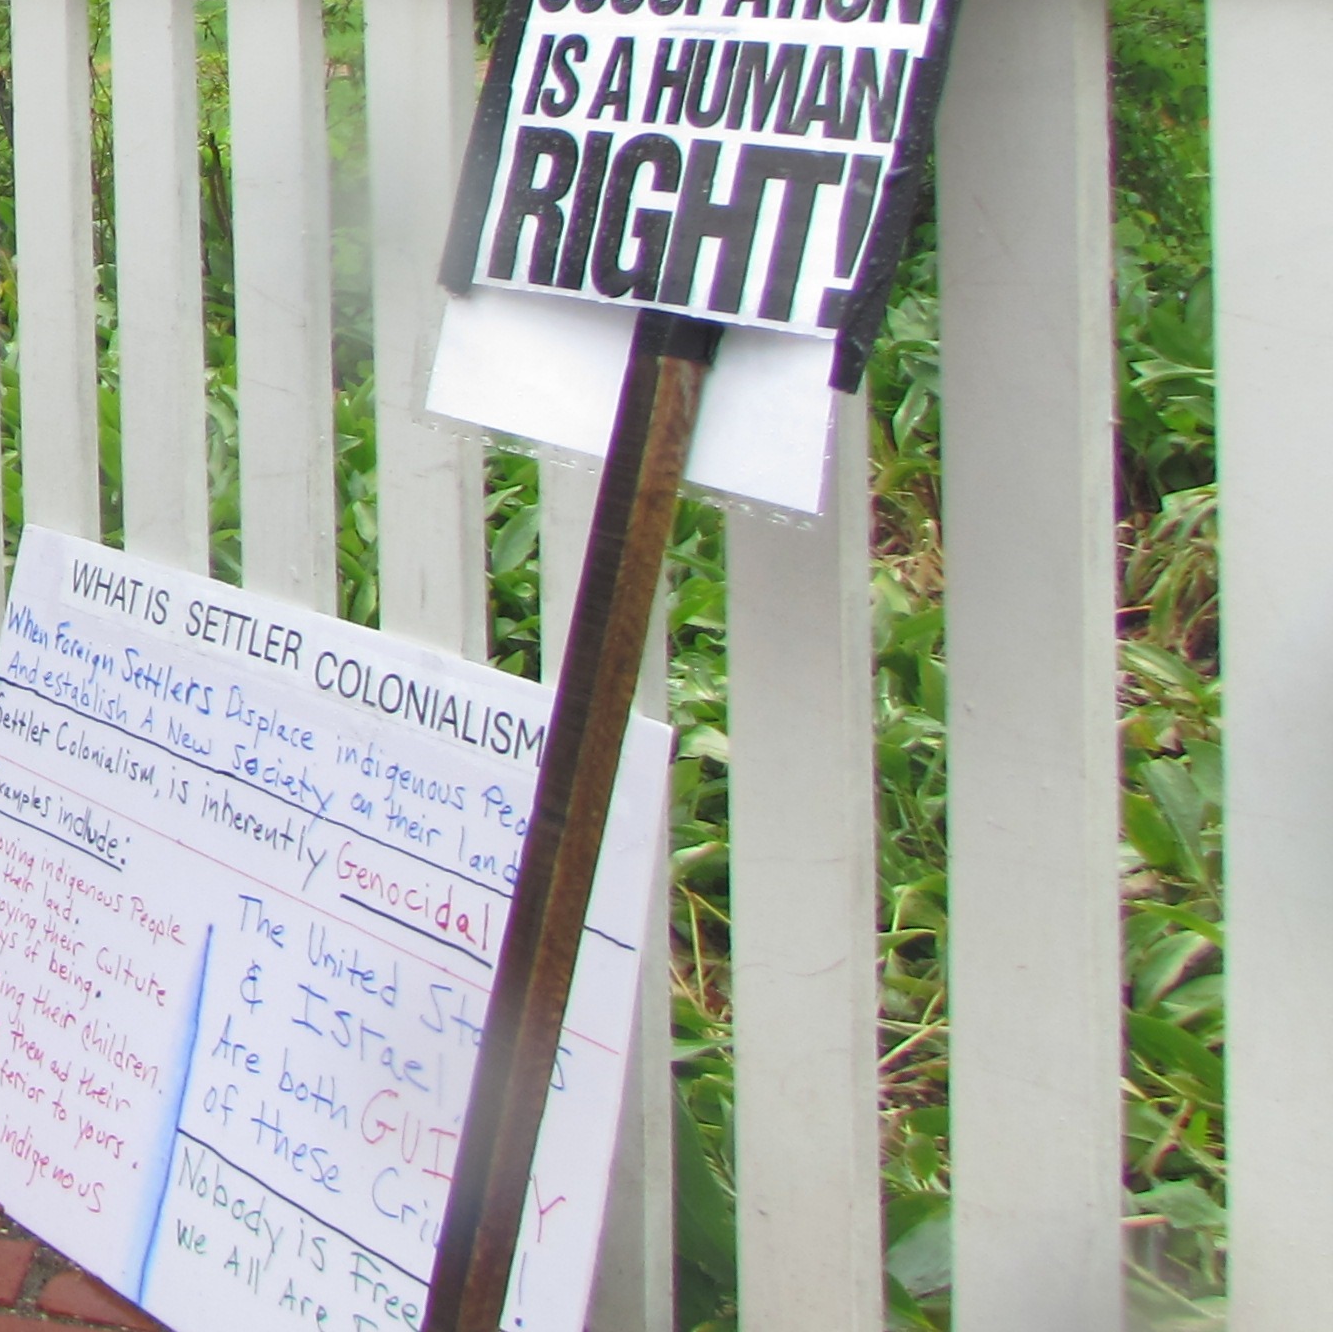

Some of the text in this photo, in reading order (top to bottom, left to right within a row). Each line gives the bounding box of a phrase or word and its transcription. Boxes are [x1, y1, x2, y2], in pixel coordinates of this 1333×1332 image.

[522, 33, 912, 144] IS A HUMAN
[489, 128, 888, 325] RIGHT!
[8, 601, 48, 650] When
[55, 621, 113, 685] Foreign
[122, 648, 213, 715] Settlers
[226, 685, 314, 749] Displace
[337, 735, 465, 811] indigenous
[73, 559, 546, 768] WHAT IS SETTLER COLONIALISM
[8, 651, 40, 684] And
[43, 671, 126, 724] establish
[140, 706, 153, 733] A
[168, 716, 211, 755] New
[232, 744, 334, 833] Society
[385, 800, 441, 847] their
[3, 863, 33, 893] their
[40, 848, 123, 913] indigenous
[169, 766, 189, 805] is
[201, 782, 327, 891] inherently
[336, 841, 490, 952] Genocidal
[25, 941, 38, 963] of
[43, 918, 85, 957] their
[238, 894, 284, 948] The
[308, 921, 397, 1008] United
[239, 959, 263, 1014] &
[33, 985, 76, 1029] their
[10, 1022, 45, 1068] them
[79, 1067, 131, 1112] their
[51, 1089, 67, 1121] to
[212, 1013, 260, 1075] Are
[279, 1047, 347, 1129] both
[0, 1114, 105, 1213] indigenous
[204, 1084, 238, 1126] of
[251, 1100, 341, 1193] these
[176, 1218, 207, 1254] We
[223, 1246, 260, 1295] All
[178, 1146, 421, 1332] Nobody is Free
